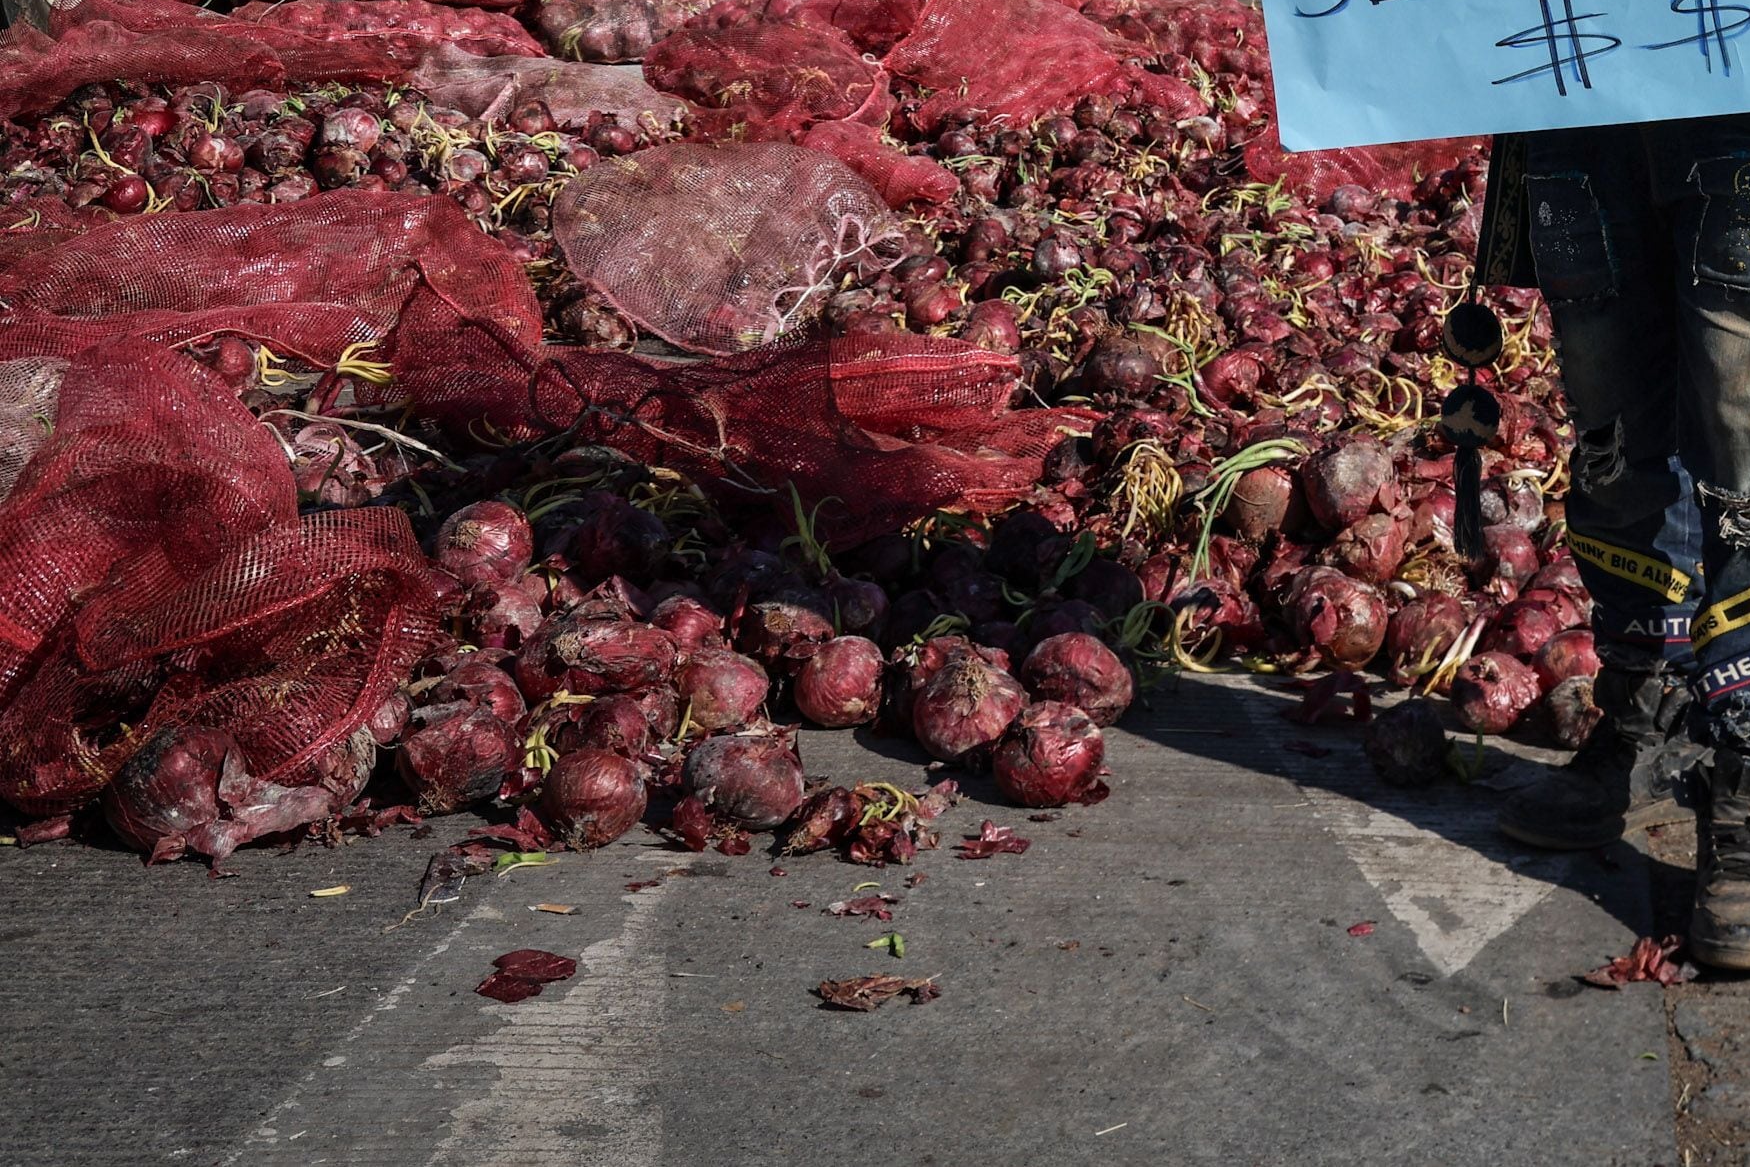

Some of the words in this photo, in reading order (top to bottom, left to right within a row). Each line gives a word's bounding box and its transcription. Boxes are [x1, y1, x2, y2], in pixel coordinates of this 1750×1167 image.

[1611, 554, 1639, 574] BIG
[1642, 565, 1689, 597] ALWAYS
[1624, 617, 1692, 636] AUT
